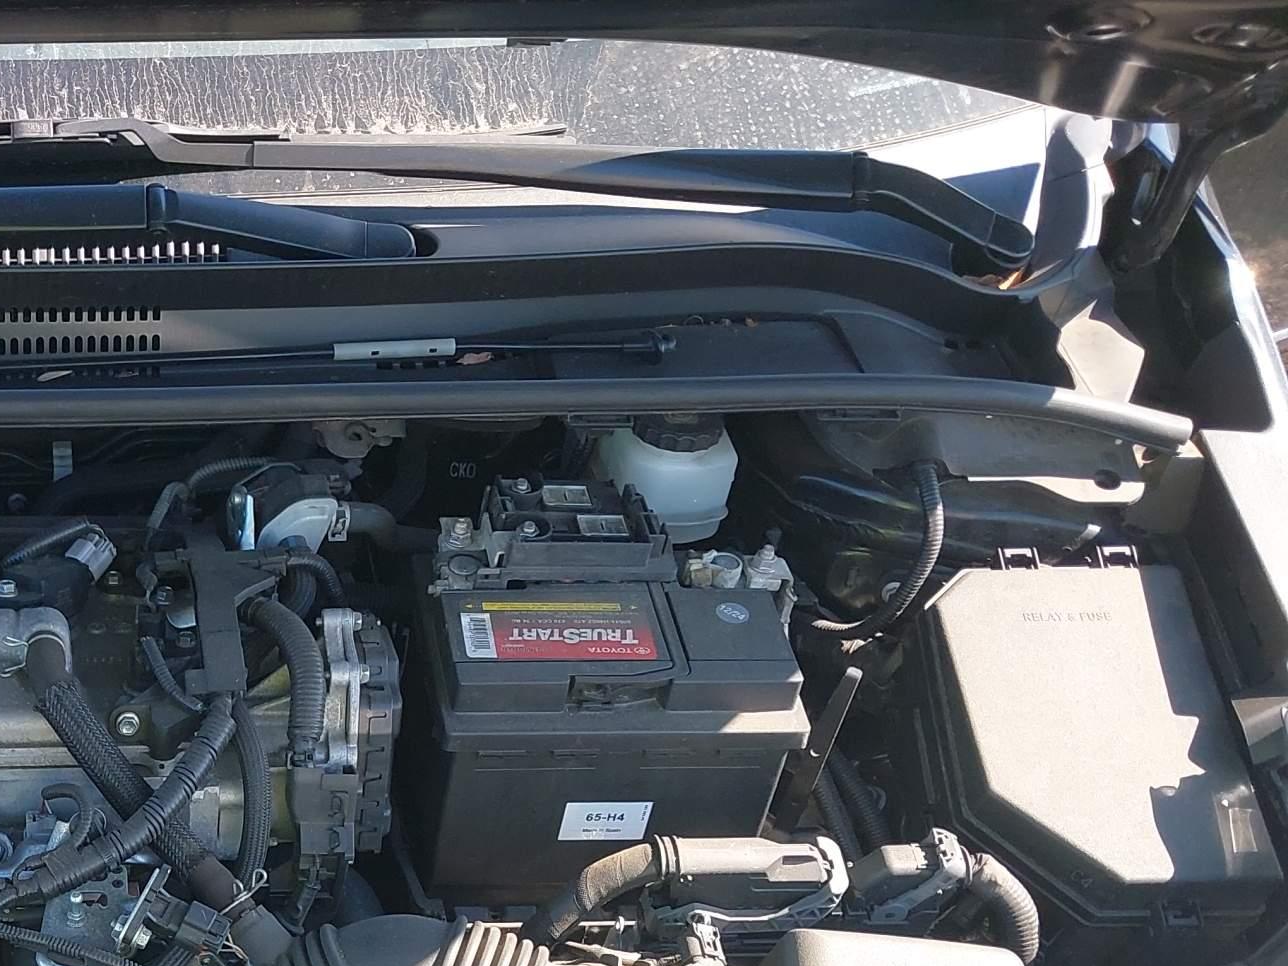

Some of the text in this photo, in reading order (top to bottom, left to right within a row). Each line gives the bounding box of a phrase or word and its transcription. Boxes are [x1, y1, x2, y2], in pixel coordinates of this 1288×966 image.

[1022, 611, 1063, 622] RELAY
[1079, 611, 1112, 622] FUSE
[587, 646, 633, 654] TOYOTA
[585, 813, 625, 821] 65-H4
